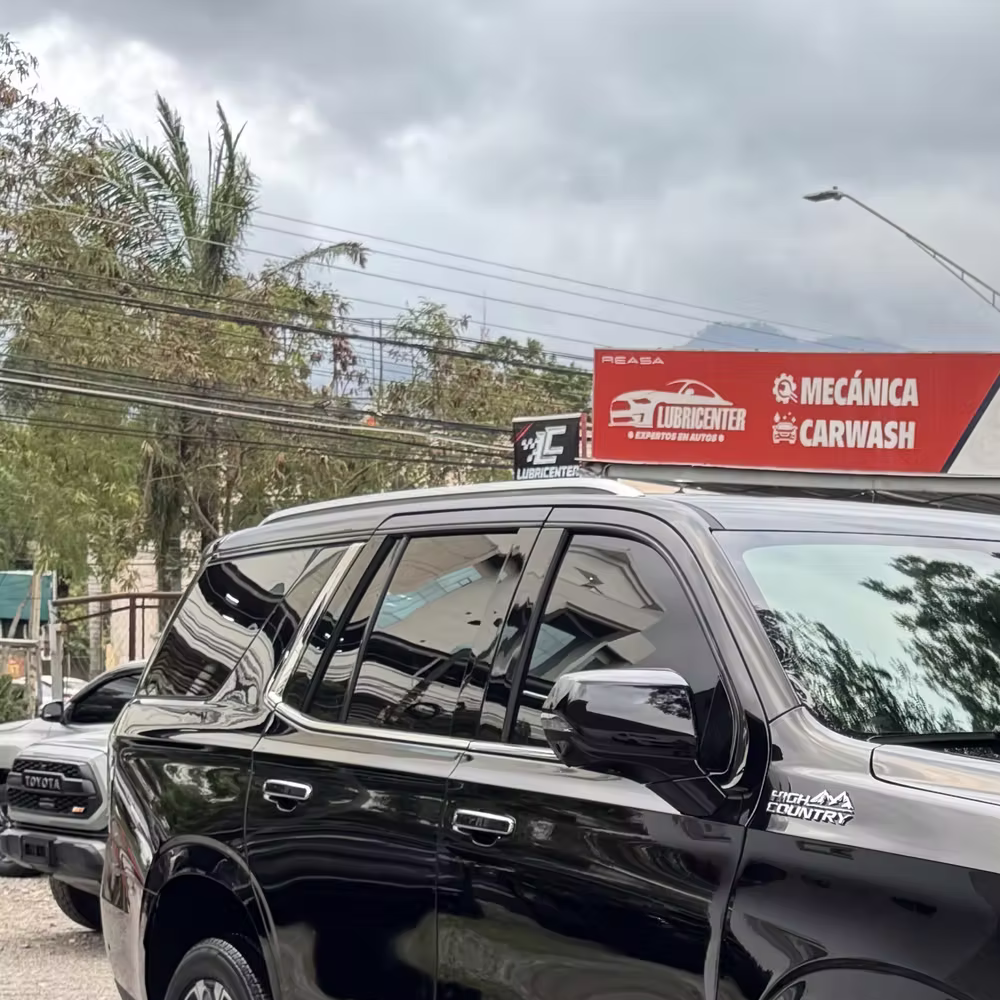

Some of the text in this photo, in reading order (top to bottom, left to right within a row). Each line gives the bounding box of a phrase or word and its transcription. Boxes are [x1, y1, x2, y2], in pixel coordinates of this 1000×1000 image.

[801, 370, 919, 406] MECÁNICA
[656, 406, 747, 431] LUBRICENTER
[634, 431, 718, 443] EXPERTOS EN AUTOS
[800, 419, 916, 449] CARWASH
[25, 775, 61, 790] TOYOTA
[771, 790, 811, 806] HIGH
[766, 802, 854, 826] COUNTRY
